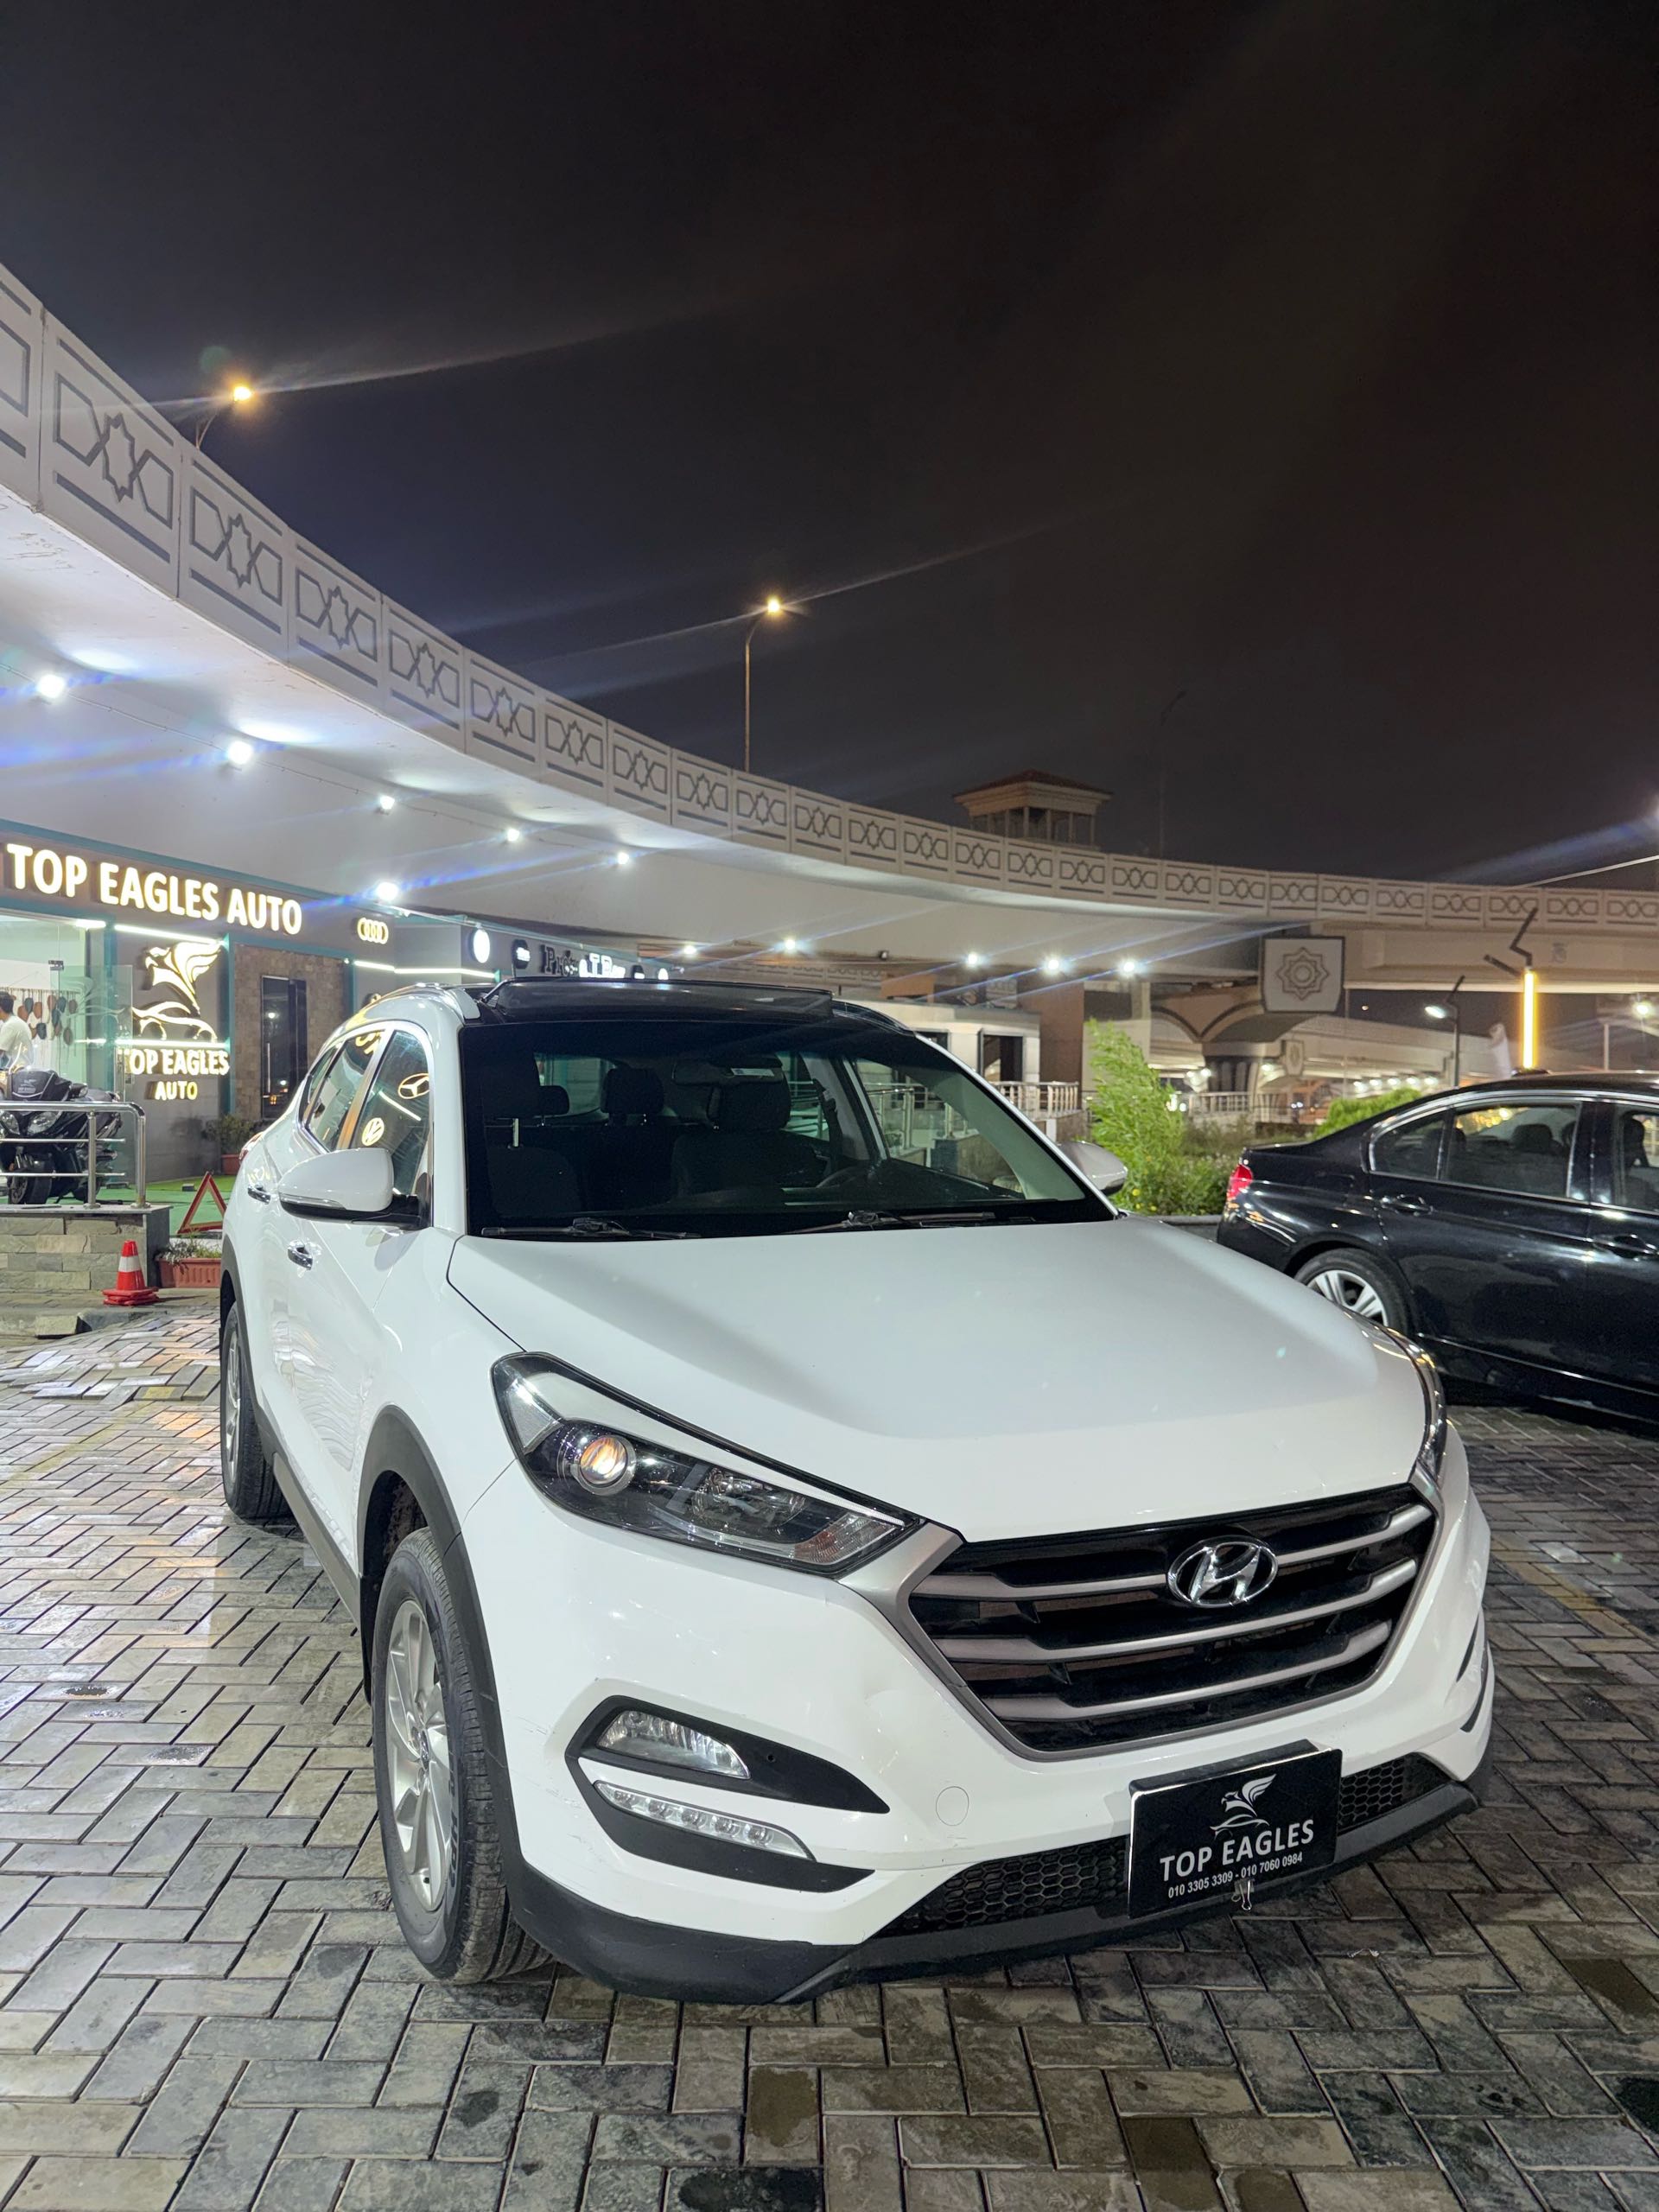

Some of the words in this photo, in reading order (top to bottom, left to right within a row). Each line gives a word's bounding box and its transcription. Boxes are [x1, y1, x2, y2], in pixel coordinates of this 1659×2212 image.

[6, 843, 87, 898] TOP
[99, 862, 219, 921] EAGLES
[226, 888, 302, 935] AUTO
[117, 1048, 159, 1075] TOP
[160, 1048, 231, 1076] EAGLES
[155, 1080, 198, 1101] AUTO
[1160, 1847, 1212, 1881] TOP
[1222, 1819, 1314, 1866] EAGLES
[1168, 1884, 1185, 1898] 010
[1187, 1878, 1210, 1893] 3305
[1211, 1872, 1233, 1886] 3309
[1241, 1864, 1256, 1878] 010
[1259, 1858, 1280, 1872] 7060
[1282, 1852, 1302, 1866] 0984
